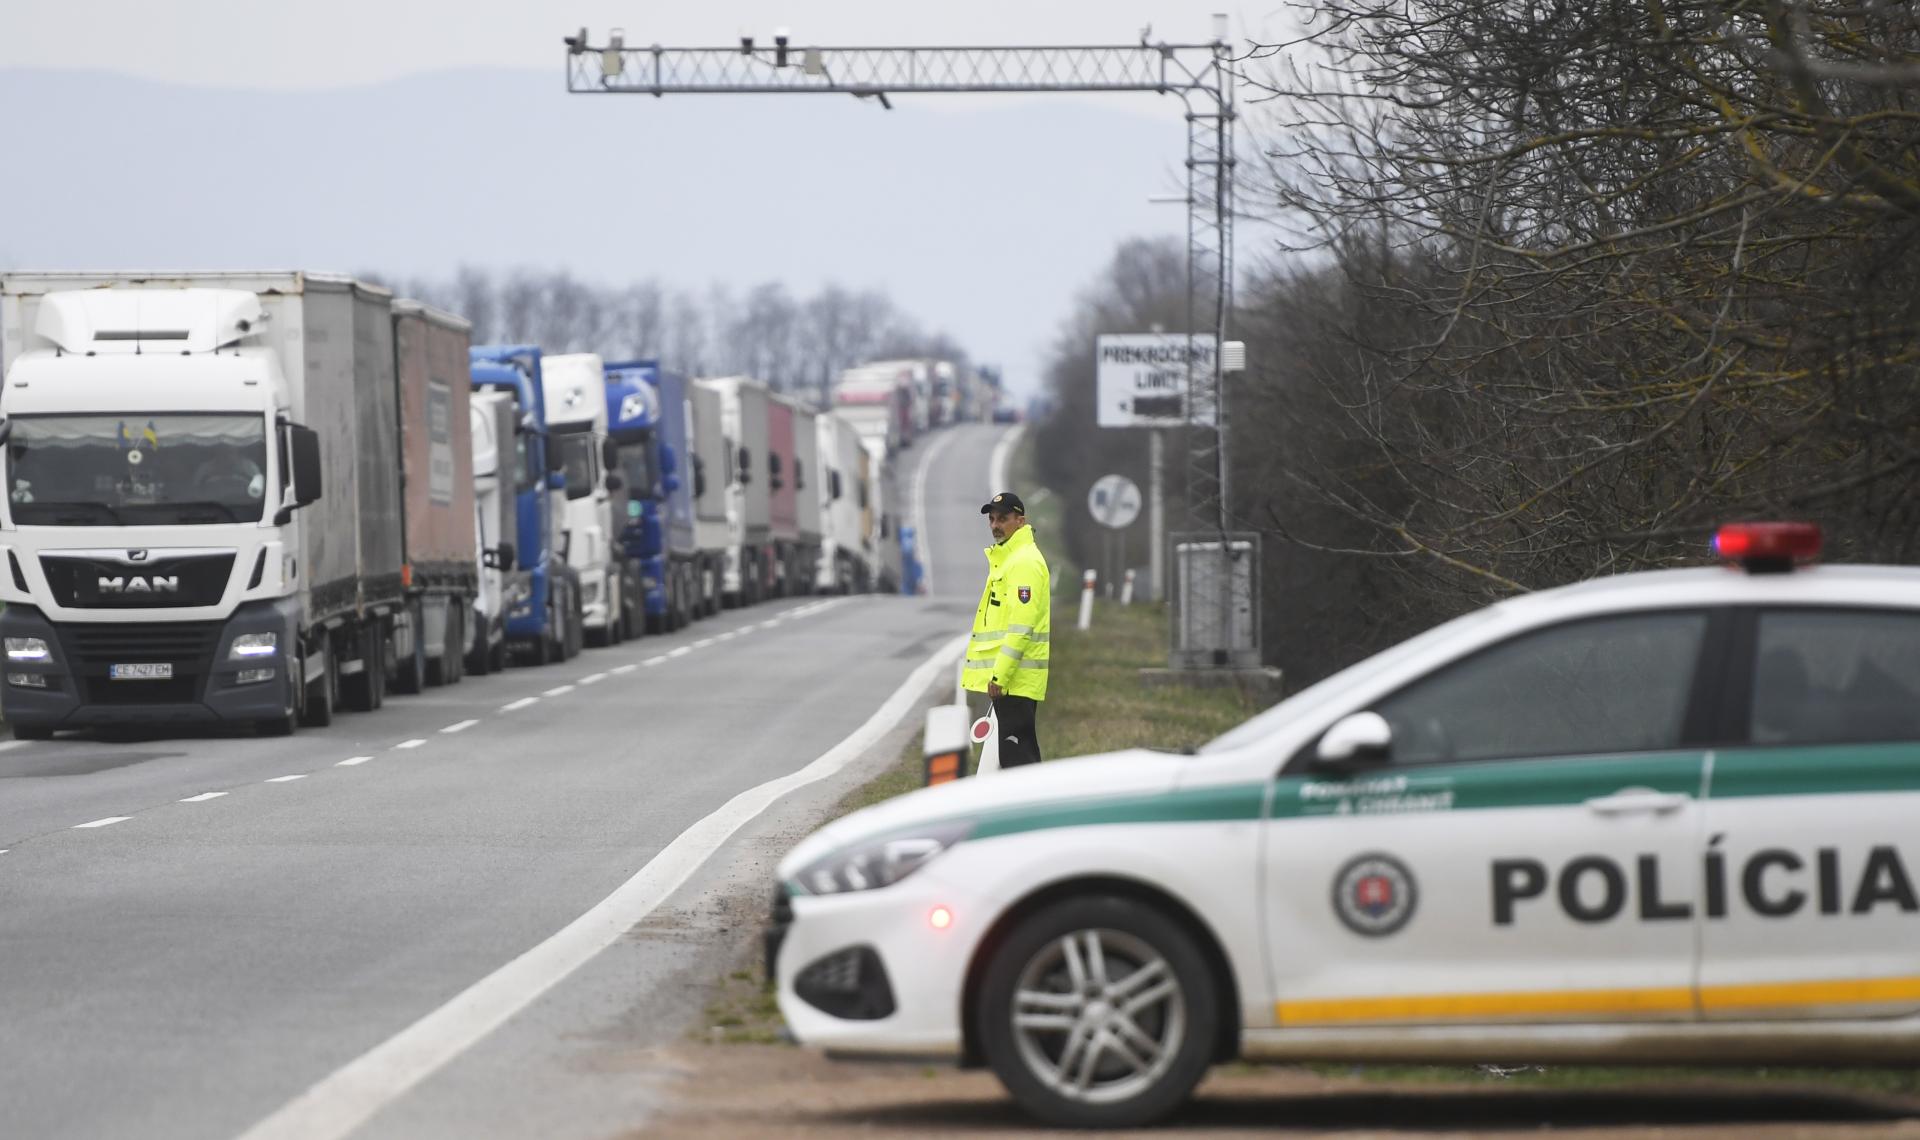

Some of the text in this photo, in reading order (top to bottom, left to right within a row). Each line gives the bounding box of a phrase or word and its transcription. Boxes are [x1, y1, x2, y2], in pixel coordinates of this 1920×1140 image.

[1134, 371, 1181, 389] LIMIT
[98, 575, 178, 593] MAN
[1491, 833, 1920, 926] POLÍCIA
